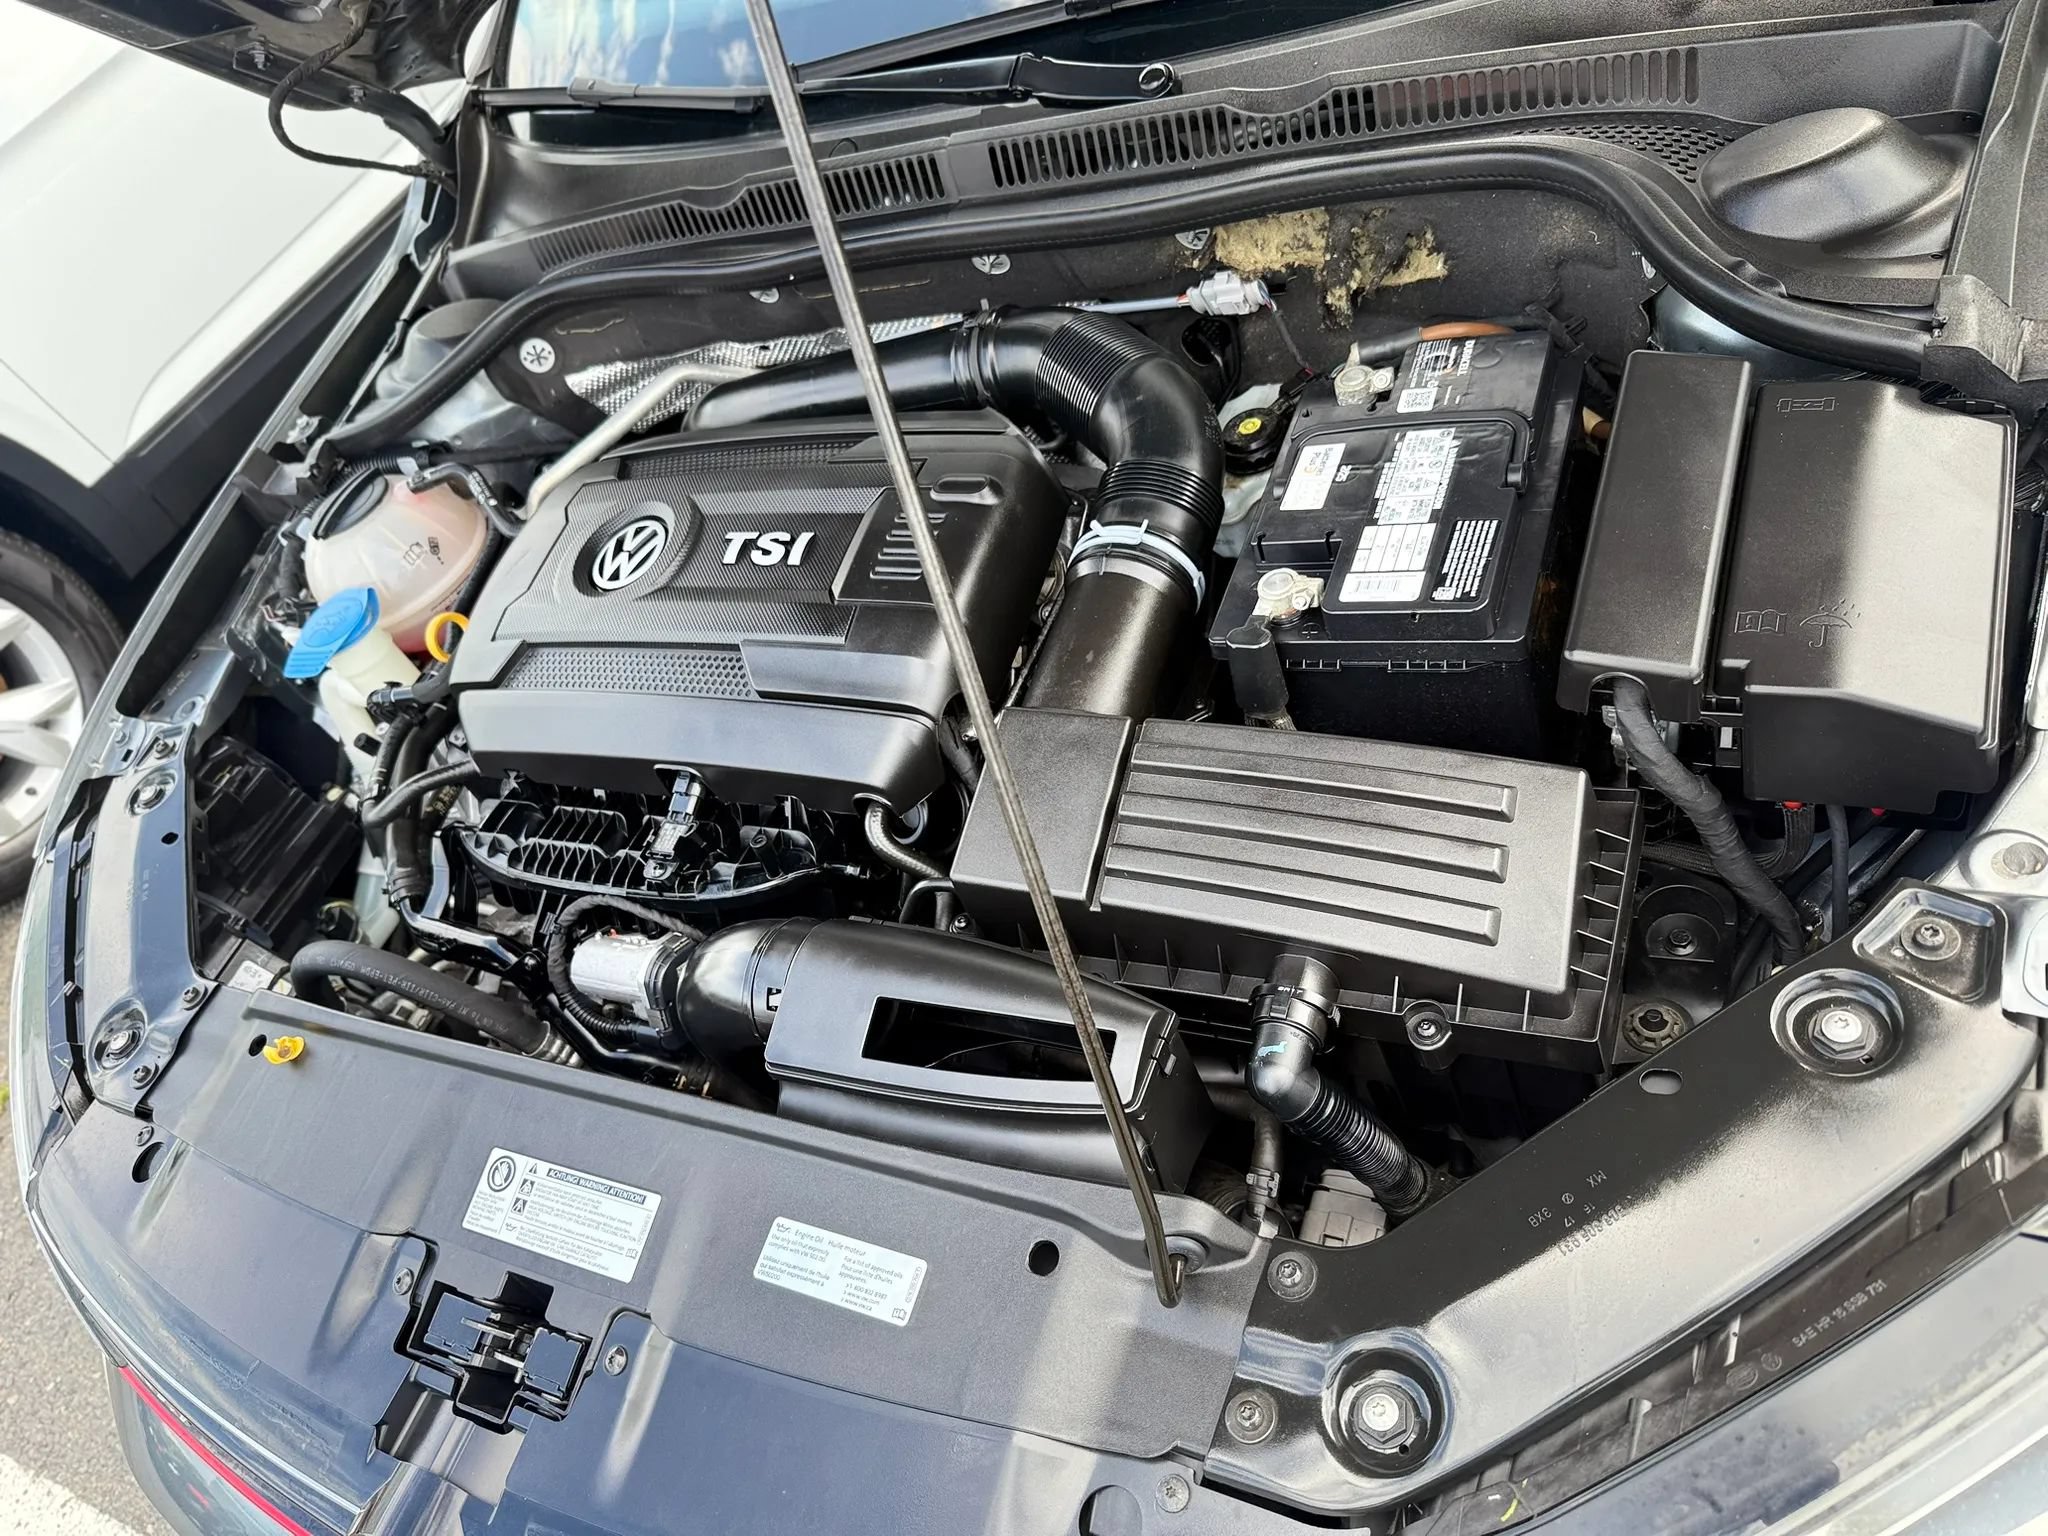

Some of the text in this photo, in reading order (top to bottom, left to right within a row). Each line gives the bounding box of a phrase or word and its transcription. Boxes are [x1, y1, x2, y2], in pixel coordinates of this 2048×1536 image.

[1457, 340, 1476, 376] DURACELL
[722, 531, 815, 567] TSI
[579, 1177, 609, 1194] WARNING!
[609, 1187, 645, 1204] ATTENTION!
[1528, 1170, 1608, 1227] MX 3XB
[793, 1228, 824, 1243] Engine Oil
[843, 1245, 866, 1256] moteur
[1792, 1326, 1817, 1347] SAE
